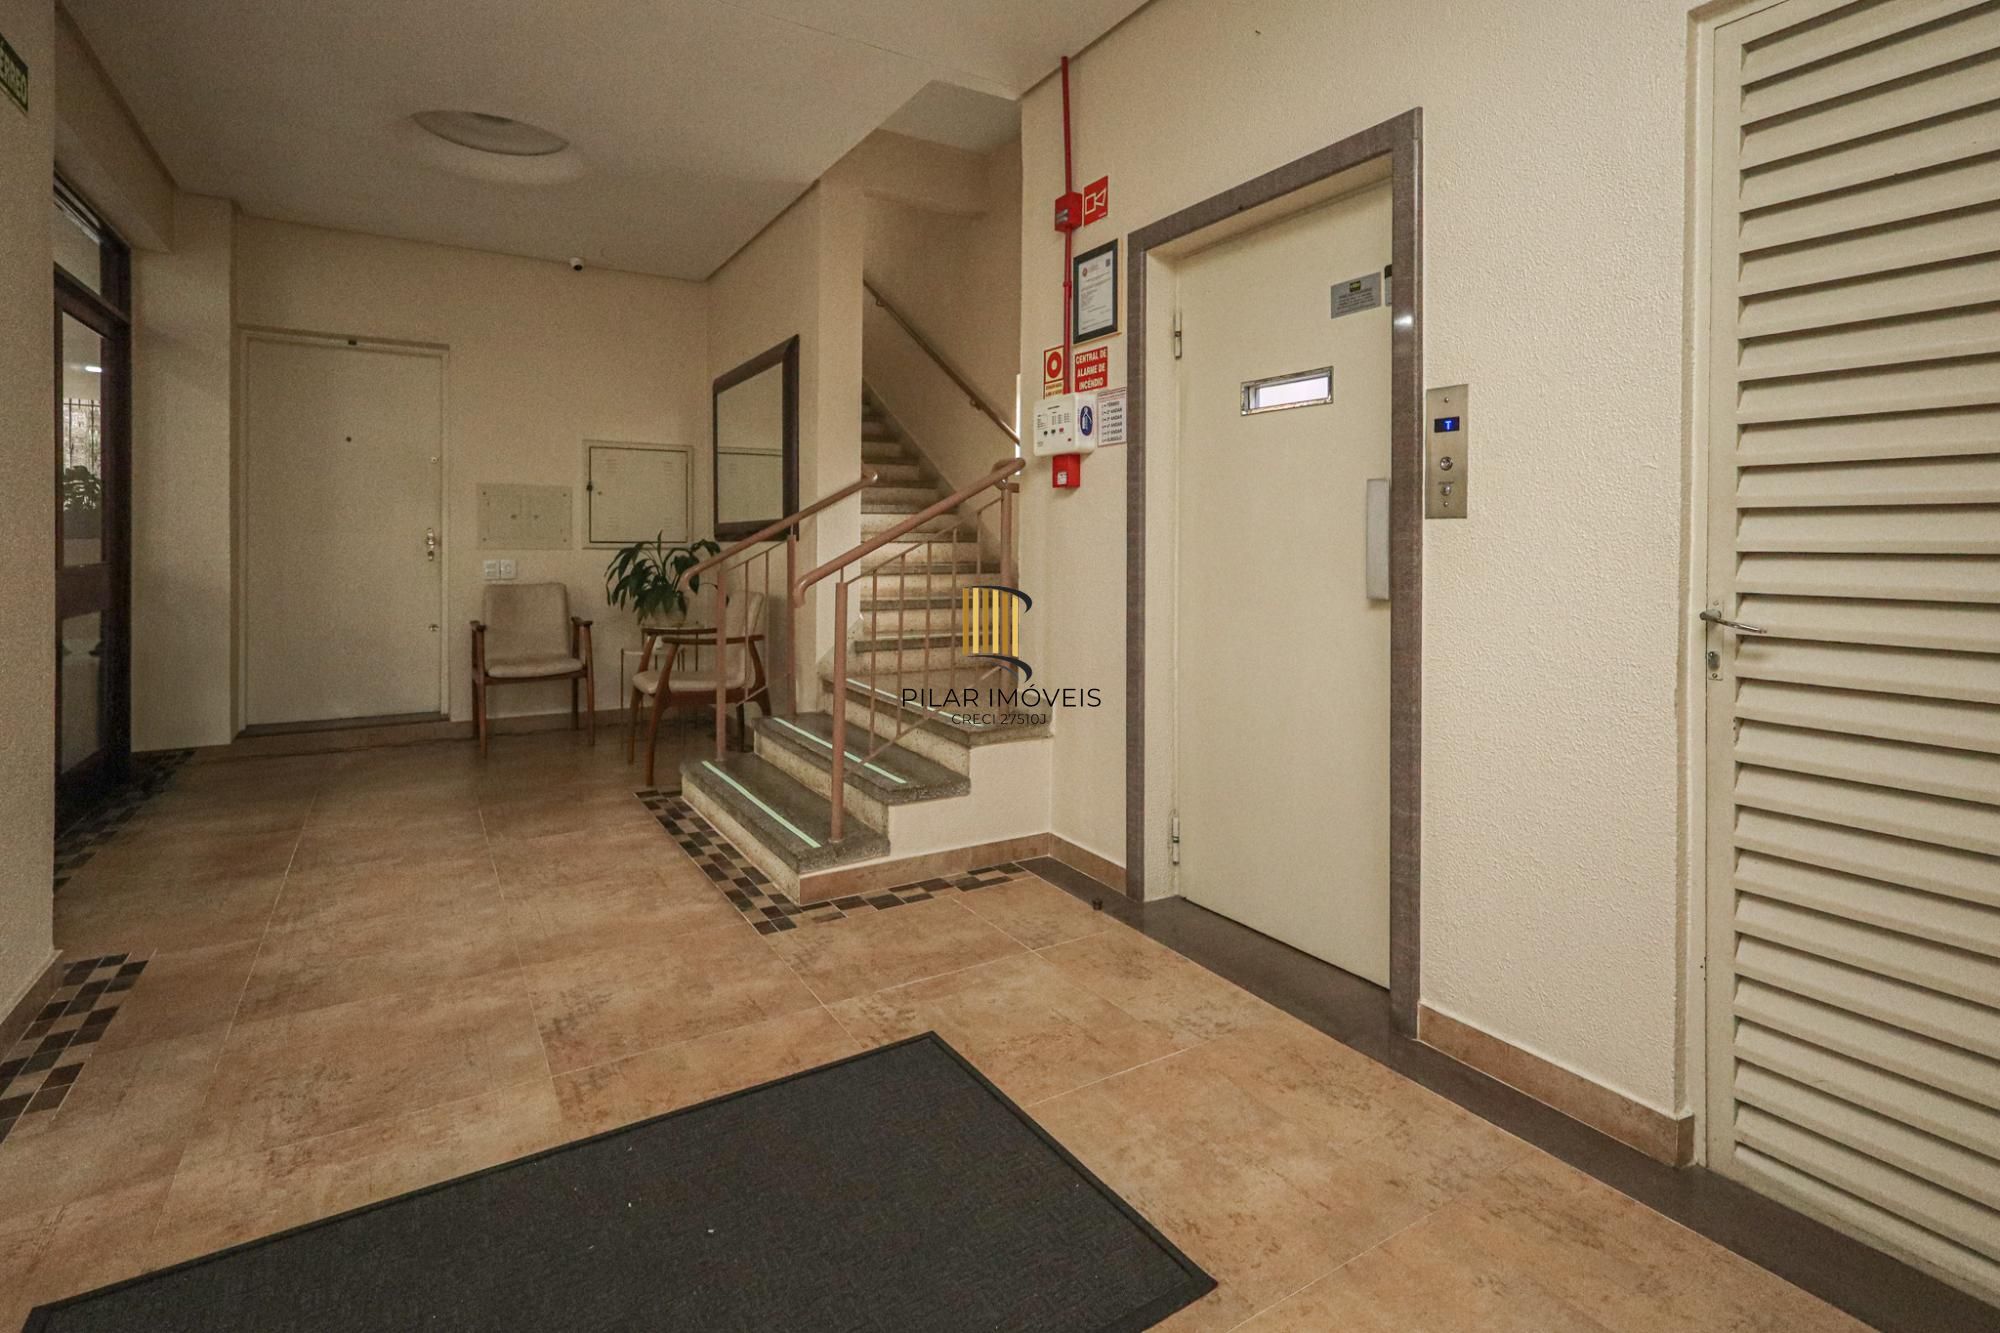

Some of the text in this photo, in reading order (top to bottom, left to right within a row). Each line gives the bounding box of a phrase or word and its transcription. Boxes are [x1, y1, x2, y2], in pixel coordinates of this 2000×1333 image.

[1076, 348, 1107, 365] CENTRAL DE
[1077, 362, 1106, 378] ALARME DE
[1445, 420, 1452, 431] T
